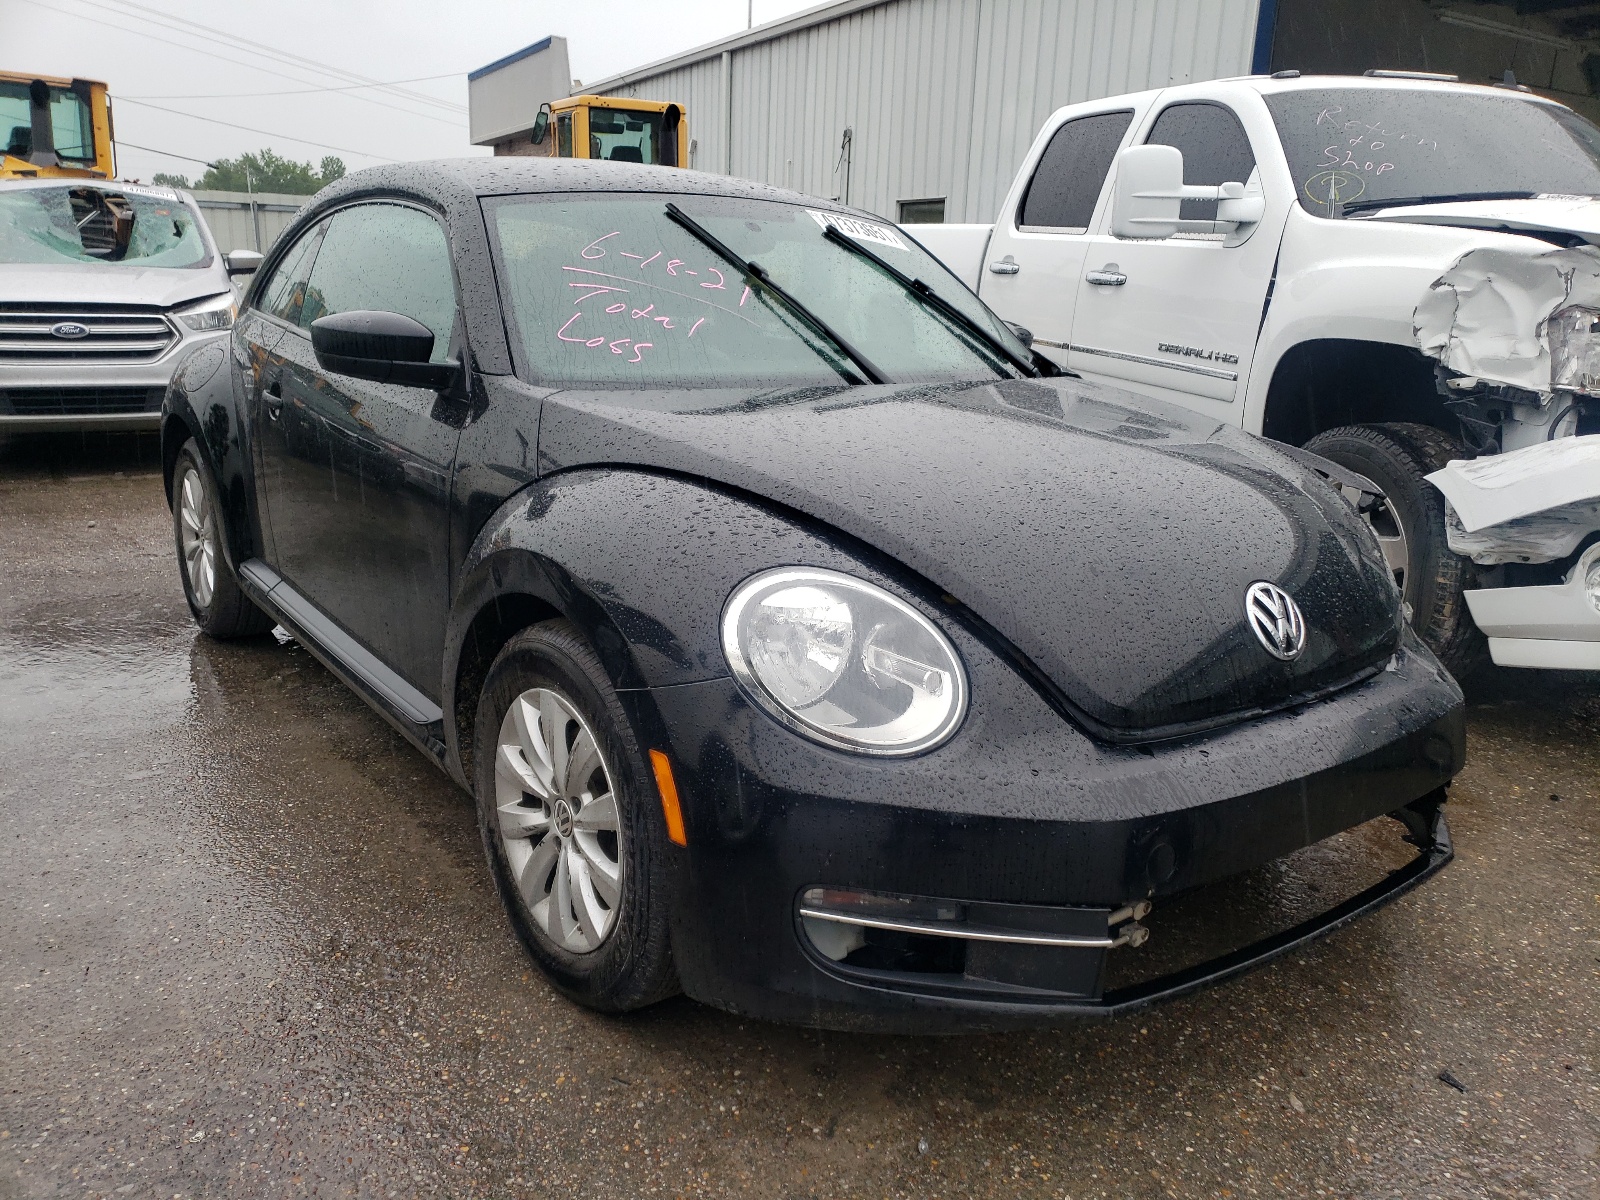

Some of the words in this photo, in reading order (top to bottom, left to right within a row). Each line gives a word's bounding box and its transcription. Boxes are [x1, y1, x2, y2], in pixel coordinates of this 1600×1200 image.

[580, 231, 750, 307] 6-18-21
[1157, 342, 1213, 361] DENALI
[1214, 350, 1239, 365] HD
